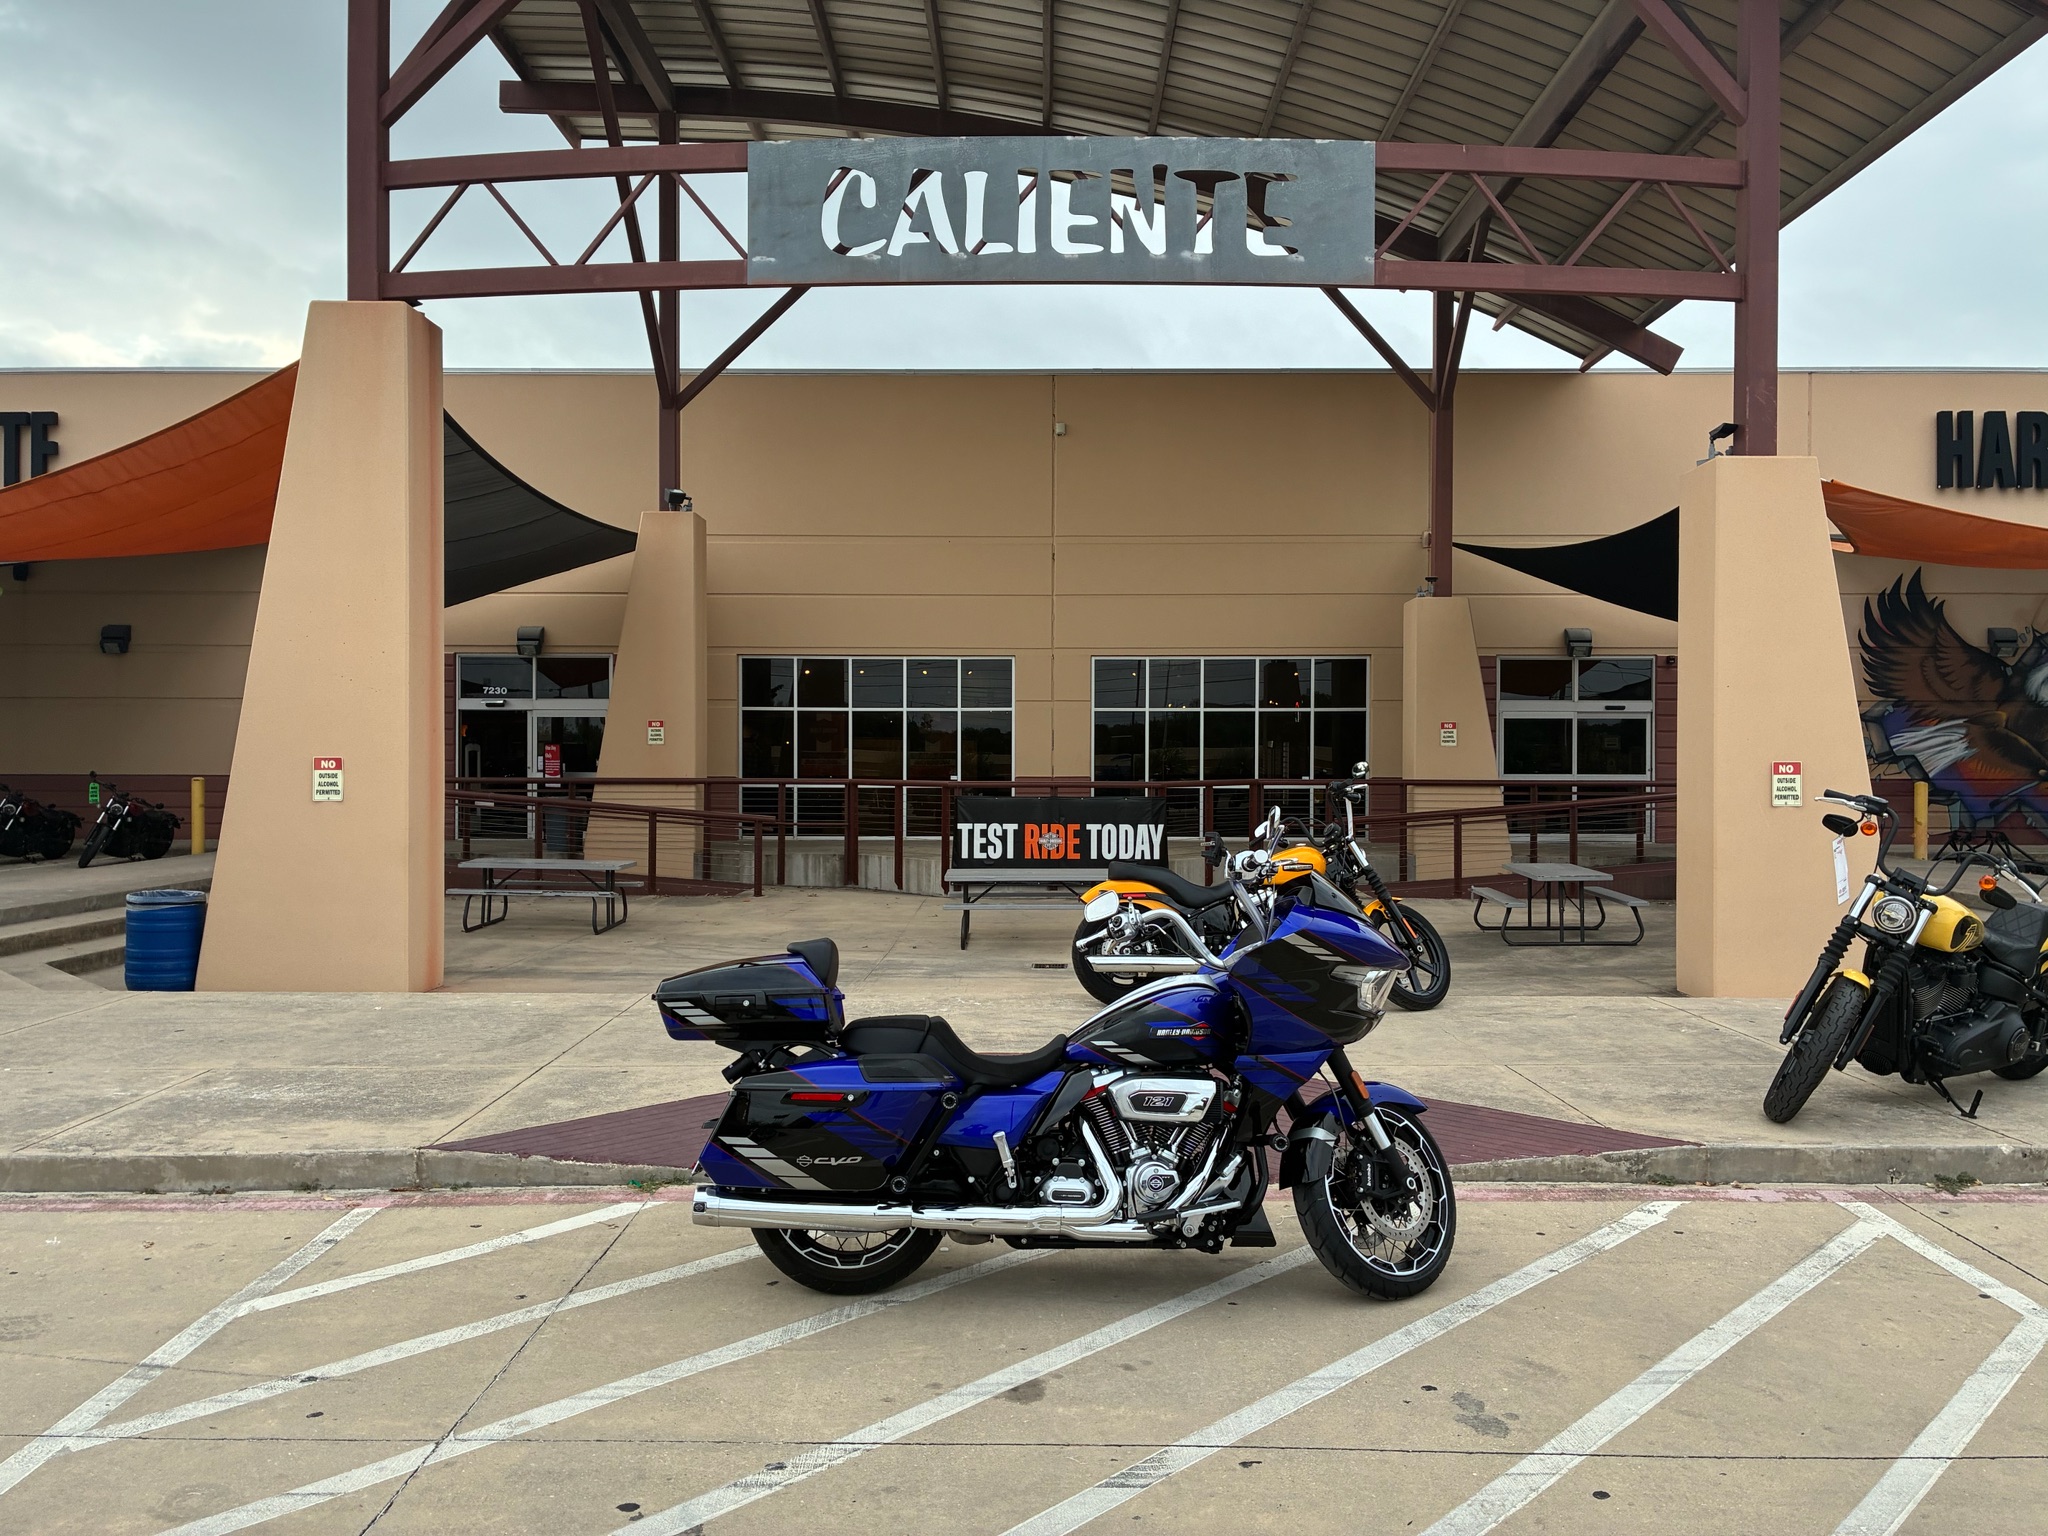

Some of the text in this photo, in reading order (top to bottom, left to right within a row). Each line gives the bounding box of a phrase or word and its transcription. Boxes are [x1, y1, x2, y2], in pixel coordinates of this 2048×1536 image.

[821, 164, 1299, 257] CALIENTE
[1936, 410, 2048, 489] HAR
[482, 686, 508, 695] 7230
[320, 759, 336, 769] NO
[1778, 764, 1794, 774] NO
[957, 823, 1018, 860] TEST
[1024, 823, 1081, 860] RIDE
[1086, 823, 1165, 860] TODAY
[1143, 1096, 1175, 1107] 121
[813, 1156, 863, 1166] CVO
